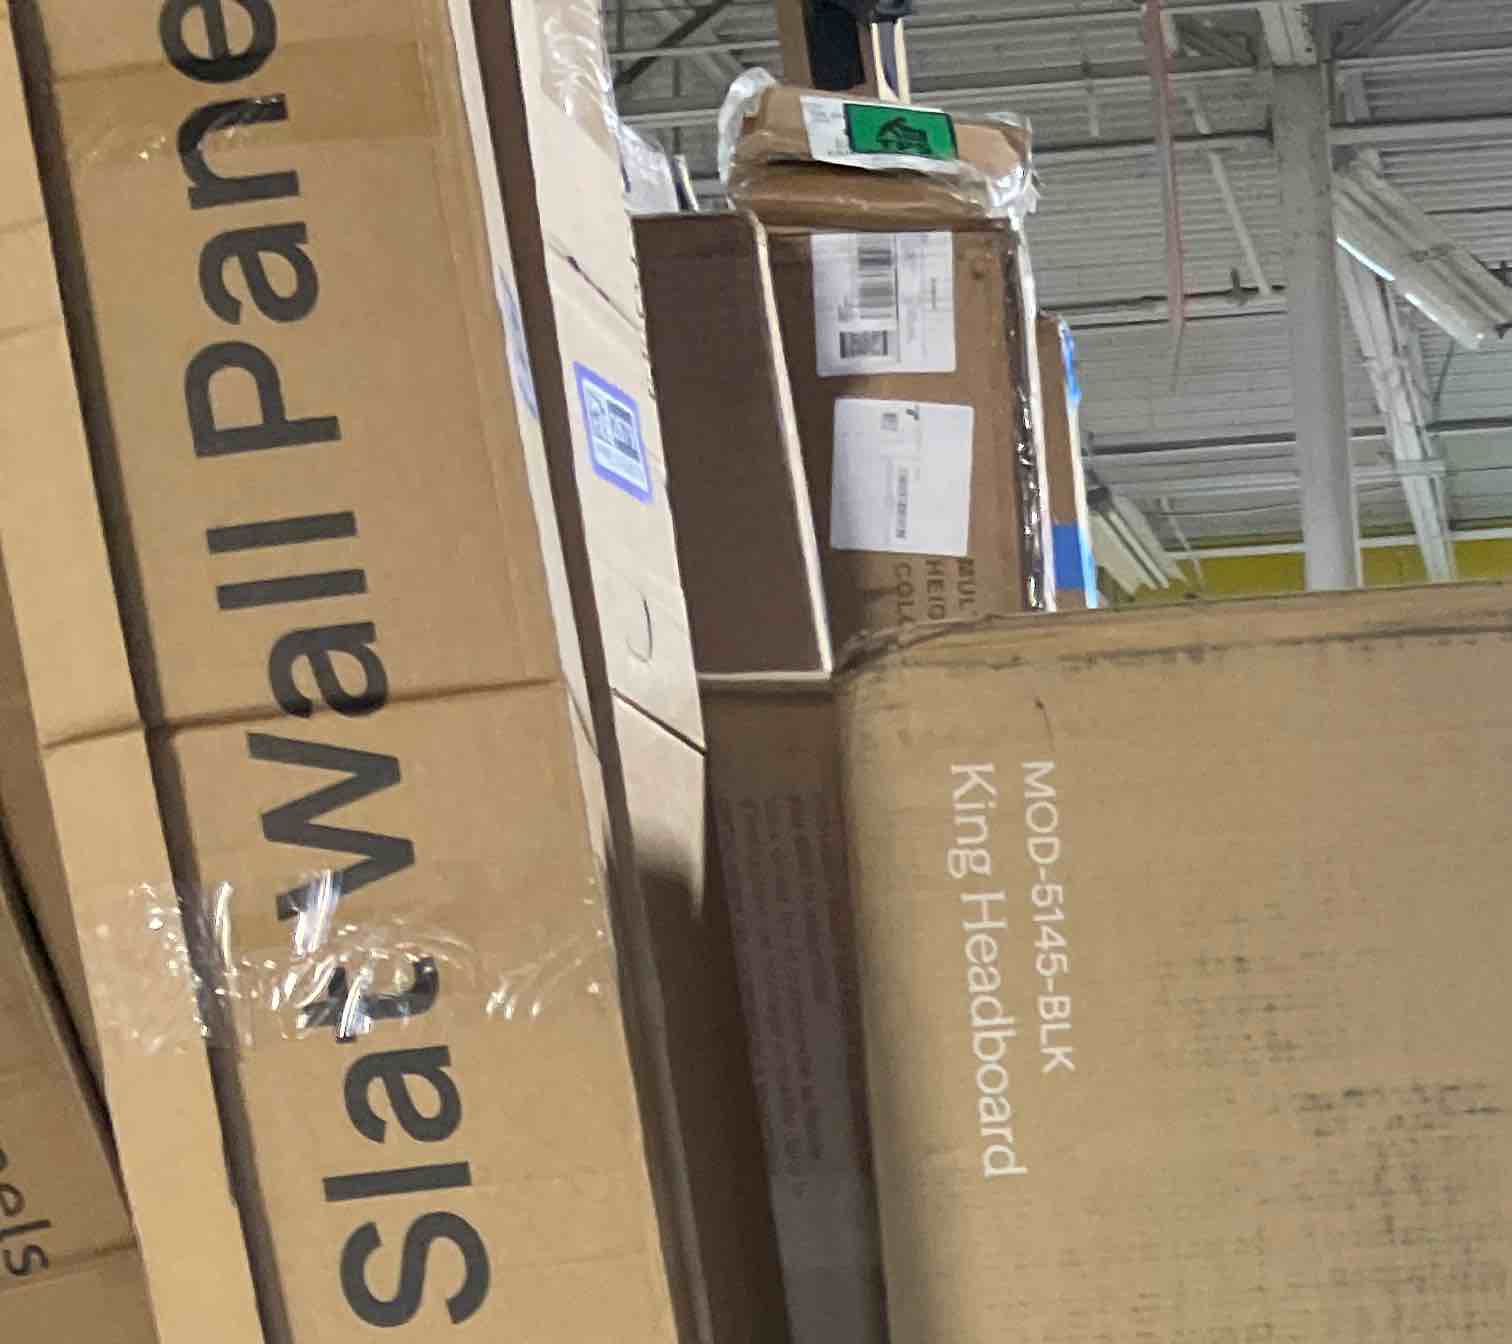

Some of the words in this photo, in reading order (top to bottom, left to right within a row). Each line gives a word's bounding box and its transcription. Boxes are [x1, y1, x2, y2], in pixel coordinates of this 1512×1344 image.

[206, 511, 416, 922] Wall
[946, 762, 998, 879] King
[960, 891, 1028, 1178] Headboard
[1022, 760, 1076, 1074] MOD-5145-BLK
[303, 953, 491, 1327] Slat
